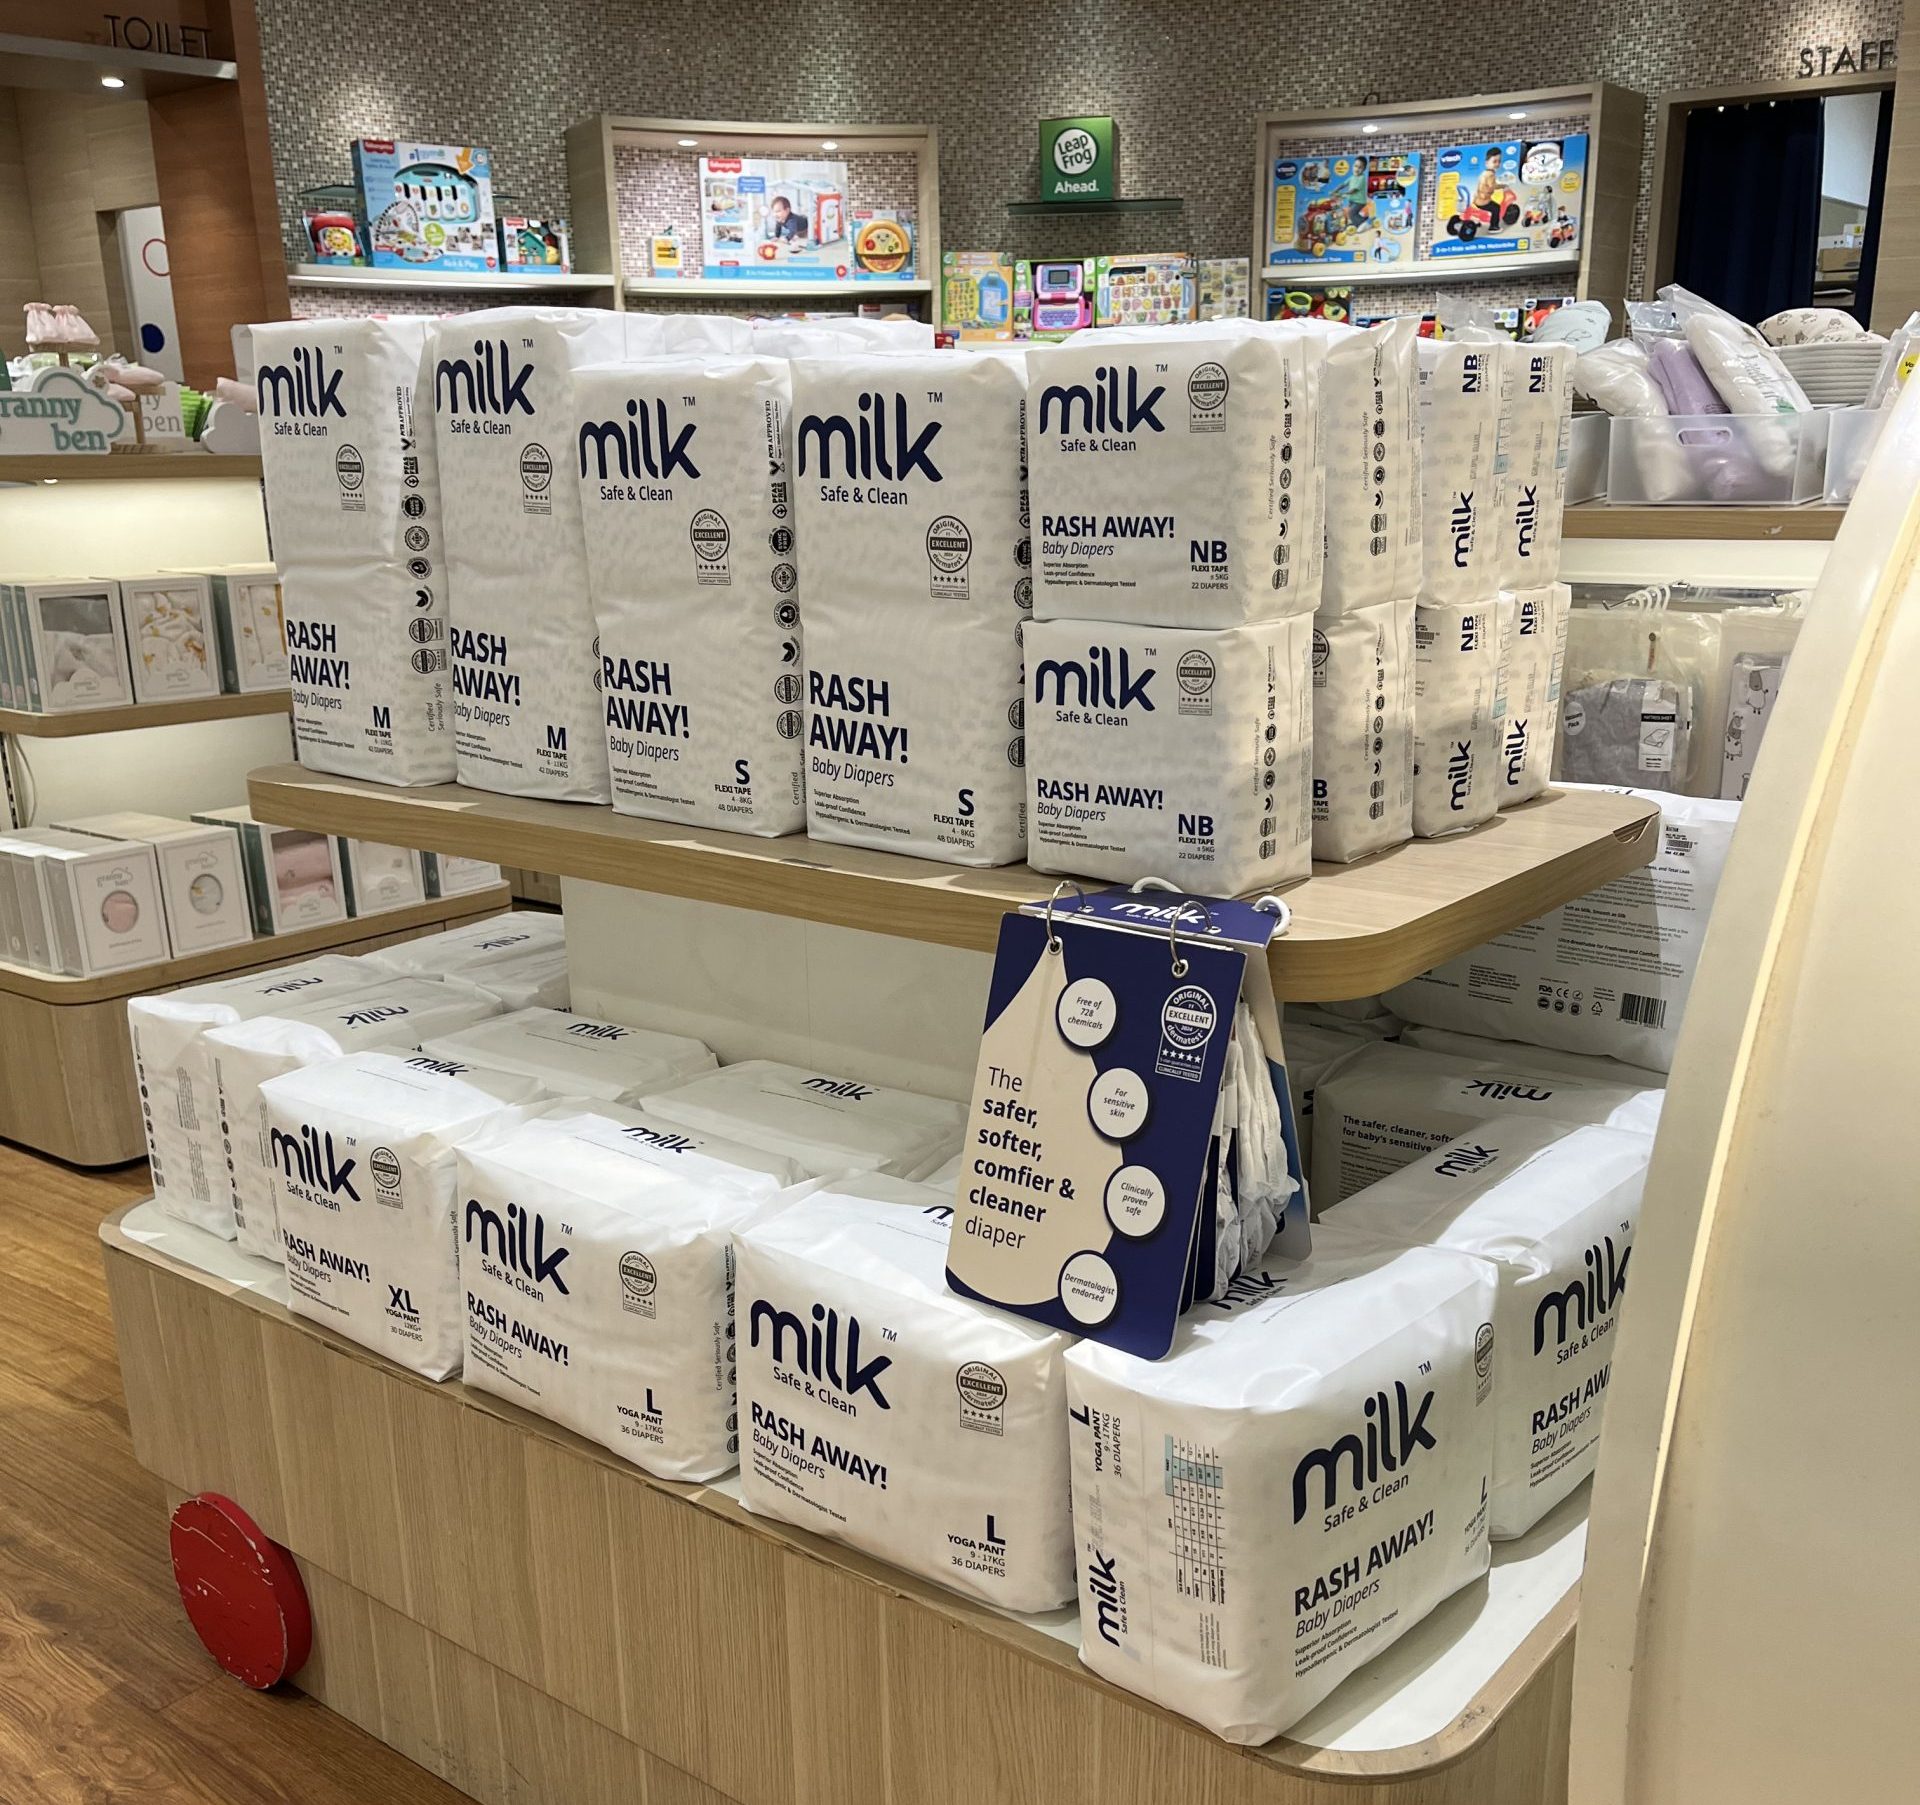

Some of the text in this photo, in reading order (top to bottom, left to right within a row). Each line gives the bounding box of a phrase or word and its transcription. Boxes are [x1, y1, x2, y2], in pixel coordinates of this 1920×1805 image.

[104, 14, 212, 59] TOILET
[1799, 39, 1897, 77] STAFF
[1058, 134, 1089, 156] Leap
[1062, 150, 1093, 170] Frog
[1054, 180, 1099, 193] Ahead.
[258, 346, 347, 418] milk
[437, 340, 535, 415] milk
[1462, 354, 1479, 393] NB
[1528, 356, 1543, 393] NB
[1040, 365, 1166, 435] milk
[51, 423, 107, 450] ben
[579, 398, 701, 480] milk
[798, 392, 943, 482] milk
[821, 486, 908, 505] Safe & Clean
[1042, 516, 1175, 539] RASH AWAY!
[1451, 491, 1474, 568] milk
[1515, 485, 1537, 558] milk
[1190, 540, 1228, 563] NB
[1192, 582, 1228, 590] 22 DIAPERS
[1461, 615, 1475, 652] NB
[1520, 601, 1534, 635] NB
[286, 619, 336, 653] RASH
[450, 627, 507, 666] RASH
[290, 654, 349, 690] AWAY!
[453, 664, 521, 706] AWAY!
[603, 655, 671, 695] RASH
[1036, 646, 1156, 712] milk
[809, 670, 889, 717] RASH
[373, 706, 391, 729] M
[607, 696, 689, 739] AWAY!
[547, 725, 566, 750] M
[810, 713, 908, 764] AWAY!
[1505, 718, 1528, 786] milk
[735, 759, 750, 785] S
[812, 756, 894, 787] Baby Diapers
[1448, 740, 1471, 811] milk
[958, 789, 974, 816] S
[1037, 778, 1163, 810] RASH AWAY!
[933, 814, 974, 828] FLEXI TAPE
[1178, 814, 1214, 837] NB
[937, 834, 975, 849] 48 DIAPERS
[1110, 902, 1208, 926] milk
[473, 934, 531, 951] milk
[1076, 996, 1102, 1009] Free of
[1172, 990, 1210, 1012] ORIGINAL
[1539, 985, 1552, 993] FDA
[1067, 1015, 1104, 1031] chemicals
[1080, 1007, 1094, 1018] 728
[1168, 1010, 1210, 1026] EXCELLENT
[566, 1021, 629, 1041] milk
[1167, 1024, 1205, 1047] dermatest
[801, 1077, 873, 1101] milk
[988, 1066, 1024, 1092] The
[1158, 1065, 1199, 1080] CLINICALLY TESTED
[1103, 1096, 1136, 1110] sensitive
[1114, 1087, 1128, 1098] For
[1465, 1079, 1553, 1101] milk
[982, 1096, 1039, 1129] safer,
[1109, 1106, 1125, 1120] skin
[1343, 1115, 1360, 1126] The
[1362, 1118, 1387, 1133] safer,
[1390, 1125, 1428, 1141] cleaner,
[621, 1126, 697, 1154] milk
[978, 1127, 1043, 1162] softer,
[1342, 1127, 1432, 1153] for baby's sensitive
[271, 1123, 362, 1202] milk
[1434, 1144, 1499, 1178] milk
[974, 1157, 1076, 1201] comfier &
[1120, 1181, 1154, 1199] Clinically
[969, 1186, 1047, 1224] cleaner
[1121, 1194, 1148, 1208] proven
[1125, 1204, 1142, 1217] safe
[466, 1199, 570, 1296] milk
[965, 1215, 1026, 1250] diaper
[319, 1248, 371, 1284] AWAY!
[388, 1284, 419, 1315] XL
[1064, 1272, 1115, 1296] Dermatologist
[1071, 1285, 1105, 1303] endorsed
[1533, 1235, 1632, 1357] milk
[467, 1291, 569, 1367] RASH AWAY!
[751, 1299, 892, 1410] milk
[646, 1388, 662, 1416] L
[773, 1365, 857, 1418] Safe & Clean
[1070, 1404, 1090, 1428] L
[1532, 1387, 1580, 1435] RASH
[751, 1400, 888, 1491] RASH AWAY!
[753, 1429, 825, 1480] Baby Diapers
[1092, 1408, 1103, 1472] YOGA PANT
[1112, 1417, 1123, 1478] 36 DIAPERS
[1292, 1380, 1437, 1525] milk
[1324, 1474, 1409, 1533] Safe & Clean
[947, 1533, 1005, 1556] YOGA PANT
[986, 1514, 1006, 1545] L
[1294, 1509, 1435, 1616] RASH AWAY!
[1088, 1550, 1120, 1647] milk
[1295, 1579, 1381, 1639] Baby Diapers
[1295, 1619, 1352, 1657] Superior Absorption
[1295, 1651, 1337, 1678] Hypoallergenic
[1344, 1623, 1381, 1648] Dermatologist
[1381, 1609, 1399, 1627] Tested
[1295, 1625, 1358, 1667] Leak-proof Confidence
